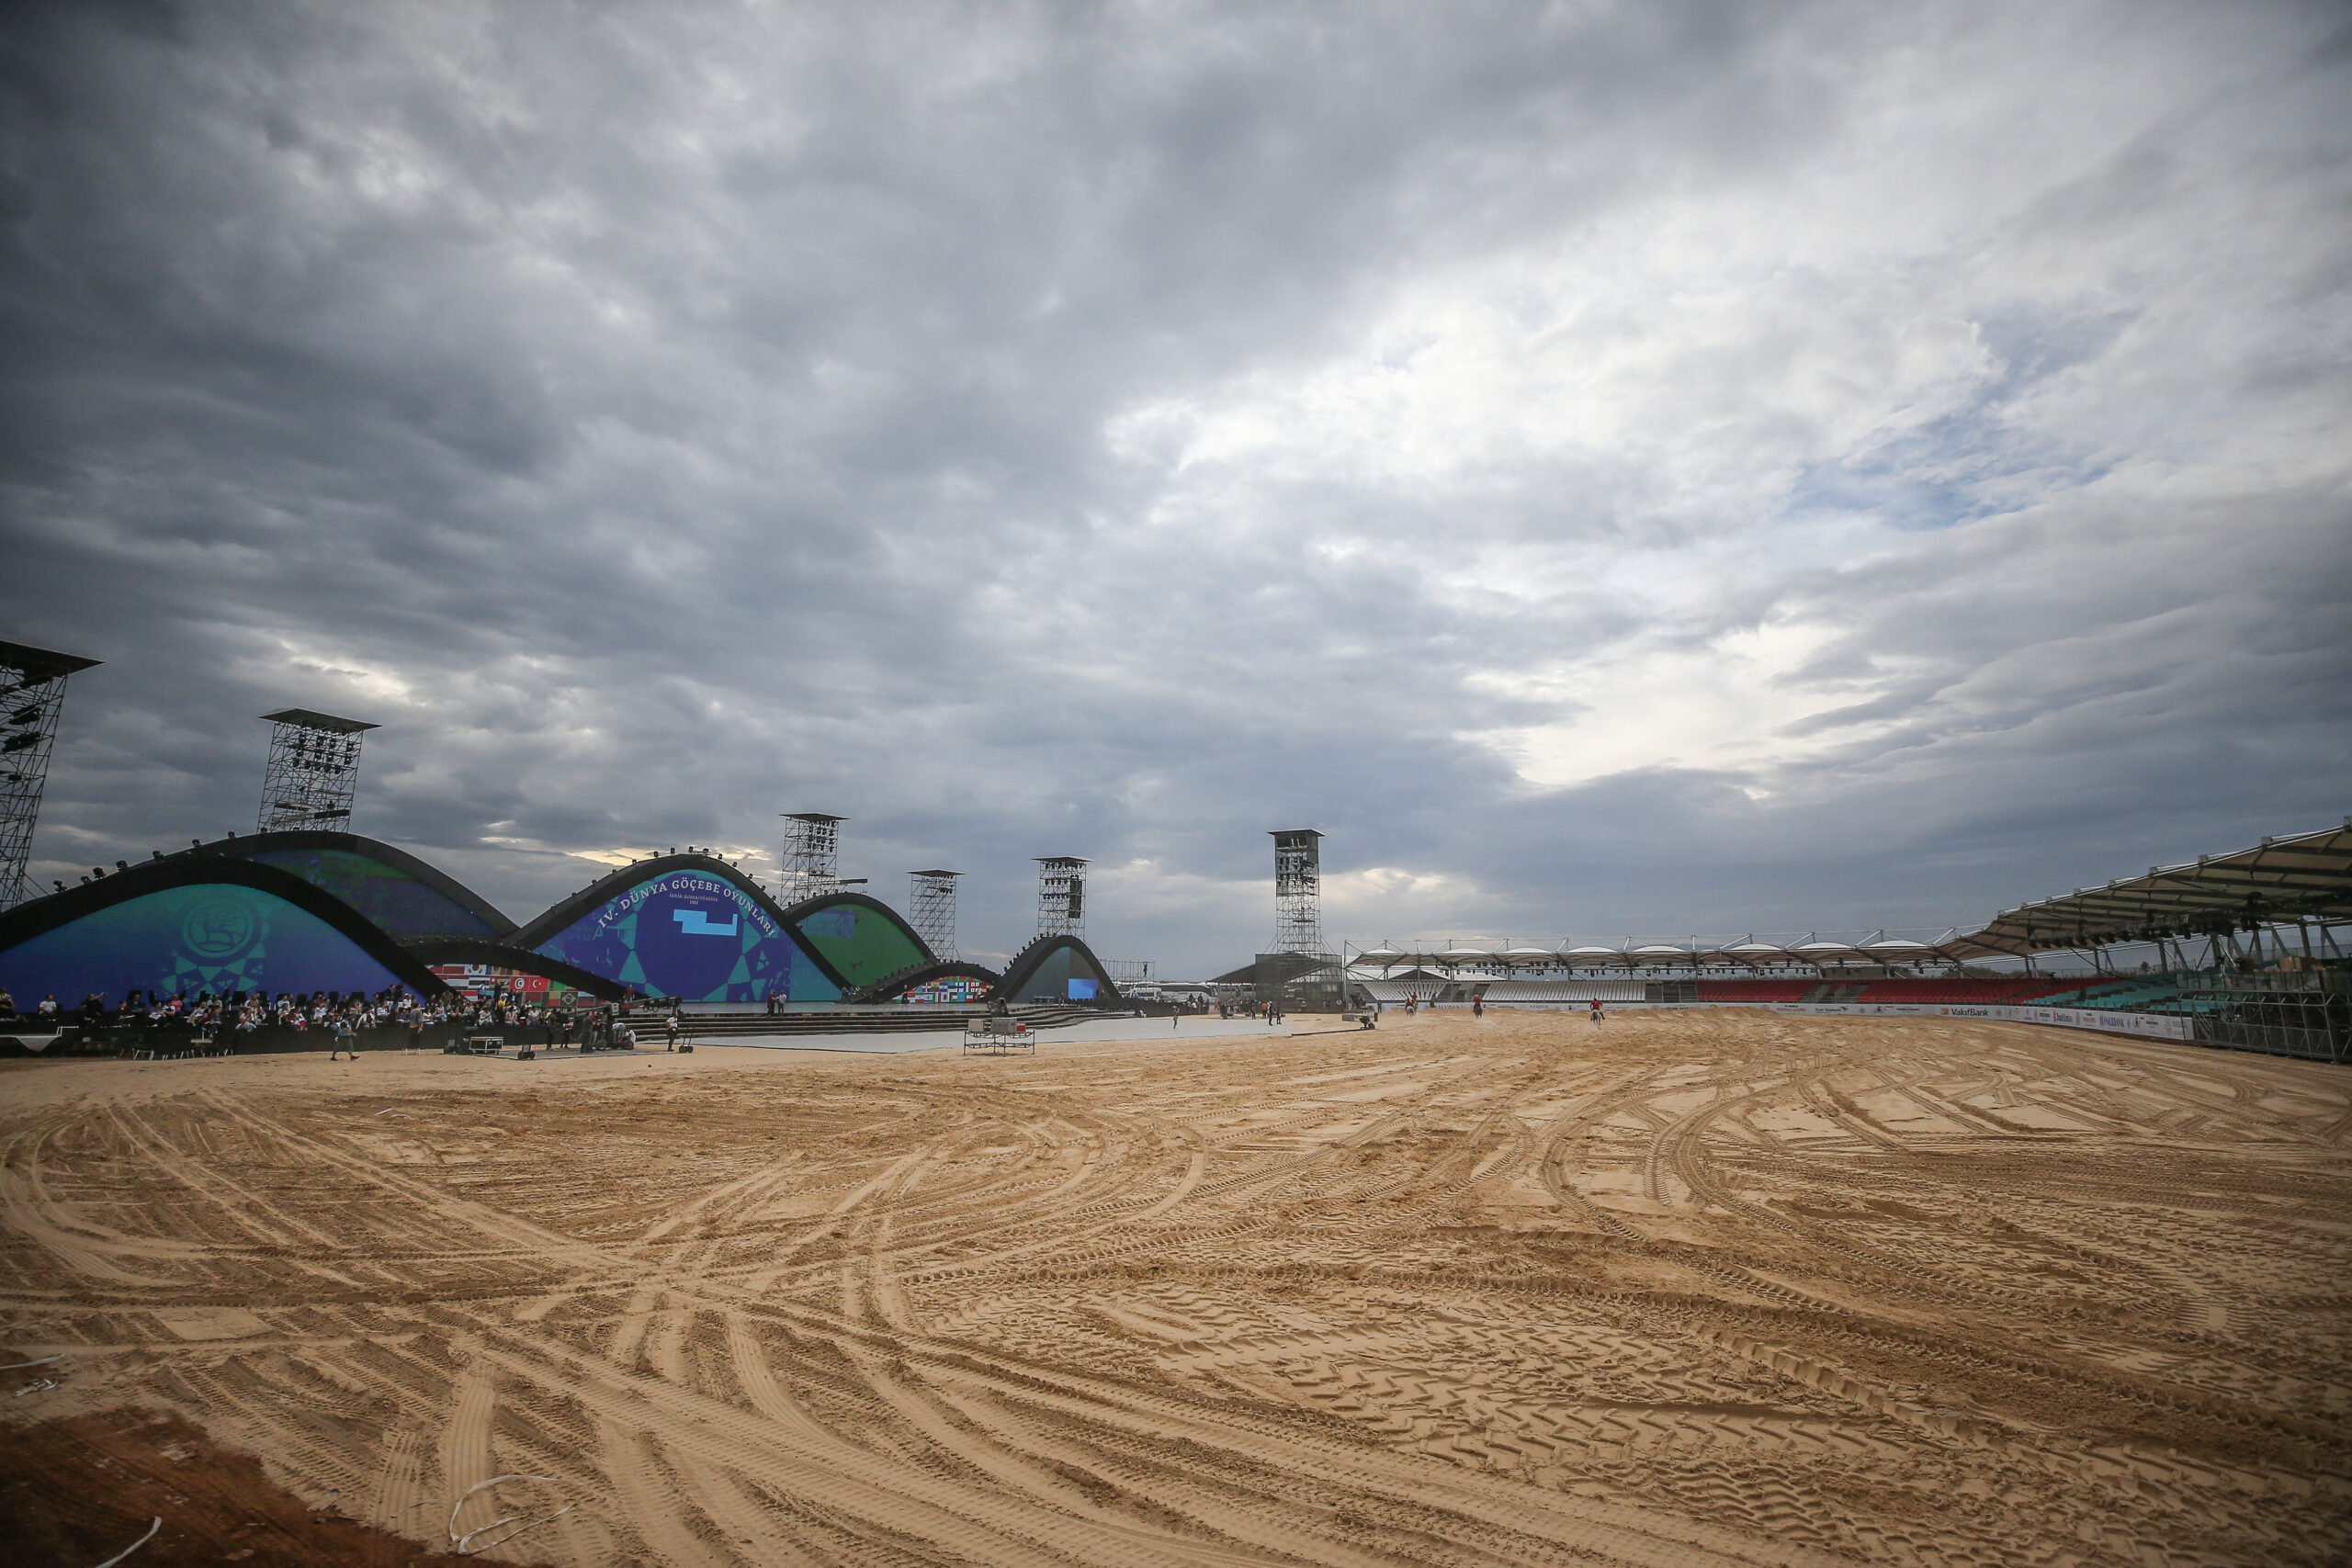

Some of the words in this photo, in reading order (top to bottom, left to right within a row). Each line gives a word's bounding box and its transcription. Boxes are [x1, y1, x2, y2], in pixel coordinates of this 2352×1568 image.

[597, 909, 618, 929] IV.
[619, 882, 668, 911] DÜNYA
[672, 876, 720, 894] GÖÇEBE
[723, 885, 776, 937] OYUNLARI
